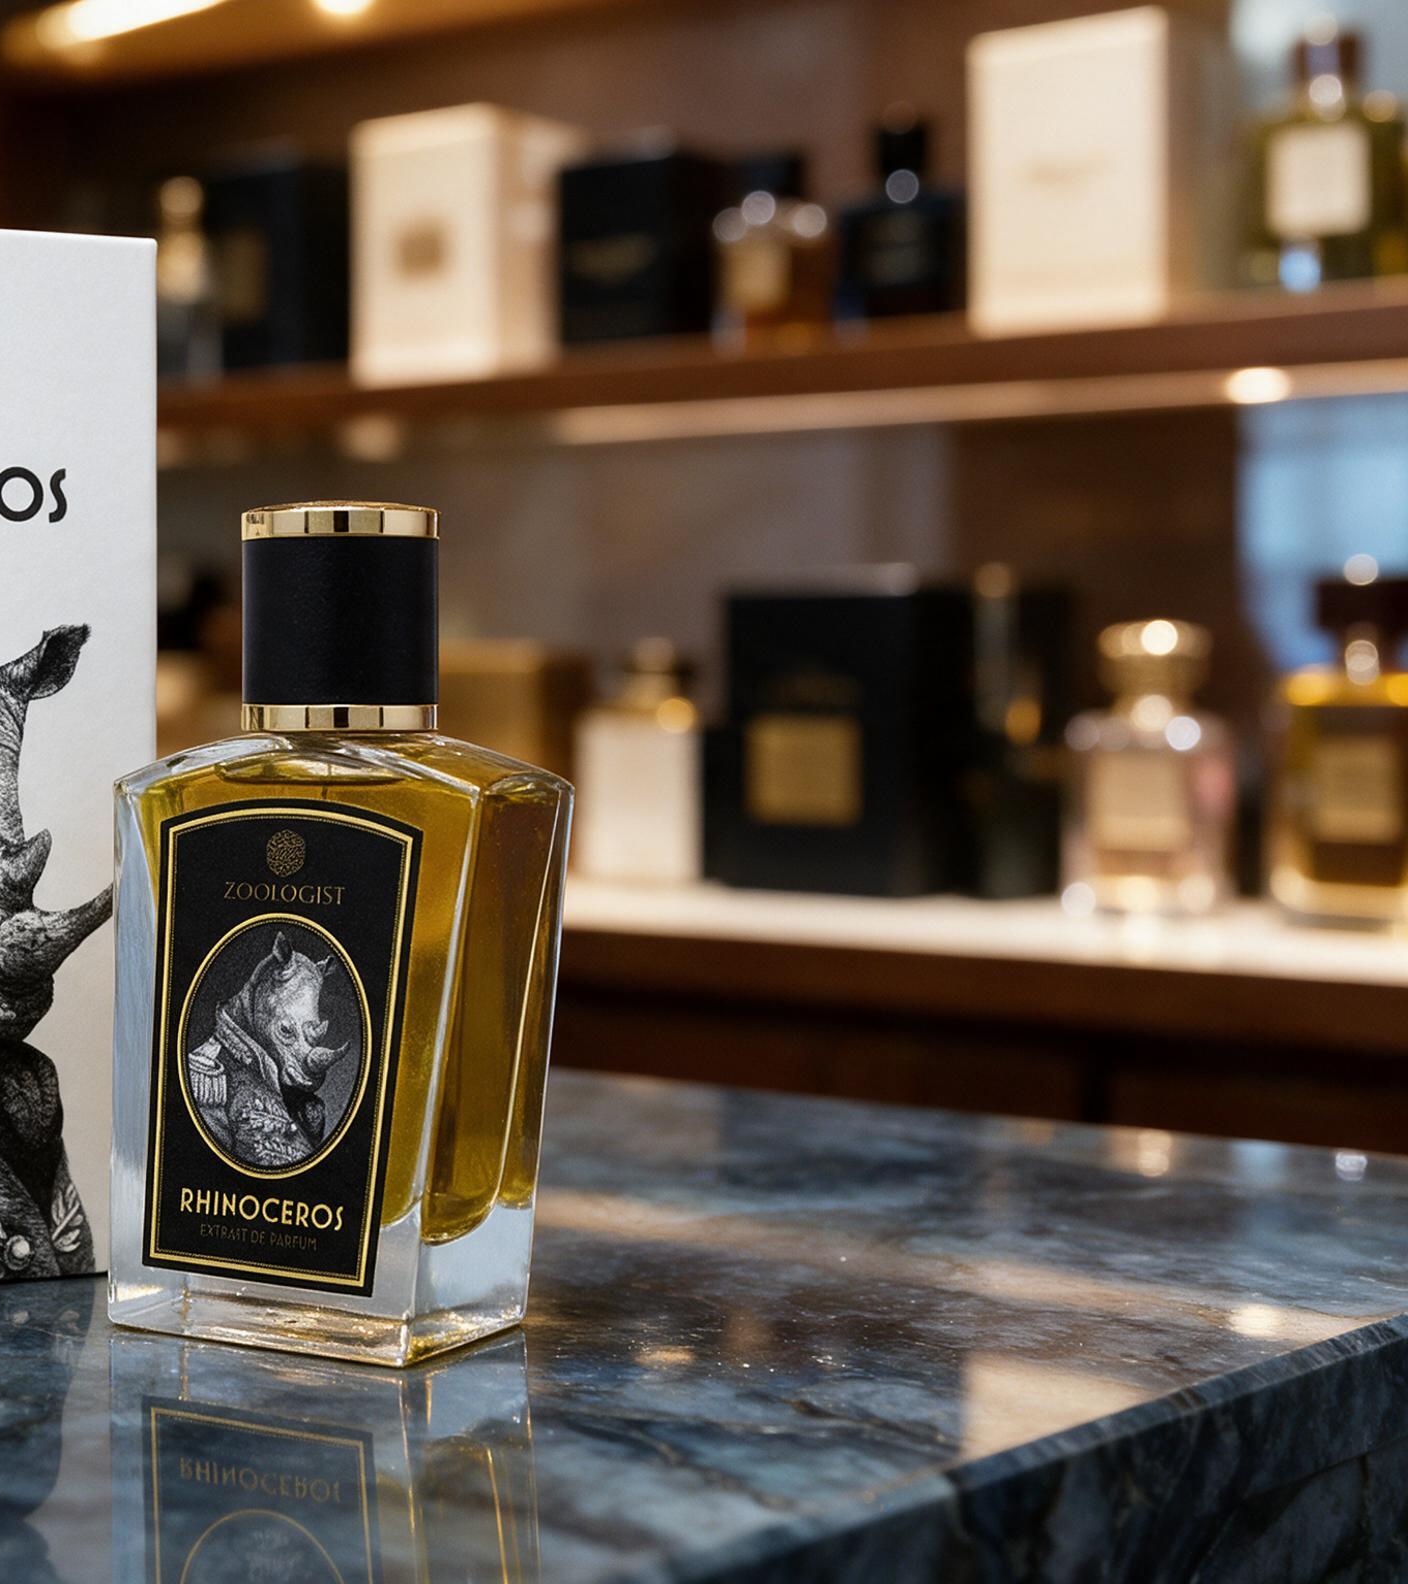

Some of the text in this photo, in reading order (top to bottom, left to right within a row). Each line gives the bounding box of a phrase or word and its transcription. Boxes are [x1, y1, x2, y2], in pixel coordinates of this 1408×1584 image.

[223, 881, 346, 905] ZOOLOGIST
[180, 1187, 344, 1231] RHINOCEROS
[200, 1223, 318, 1250] EXTRAIT DE PARFUM
